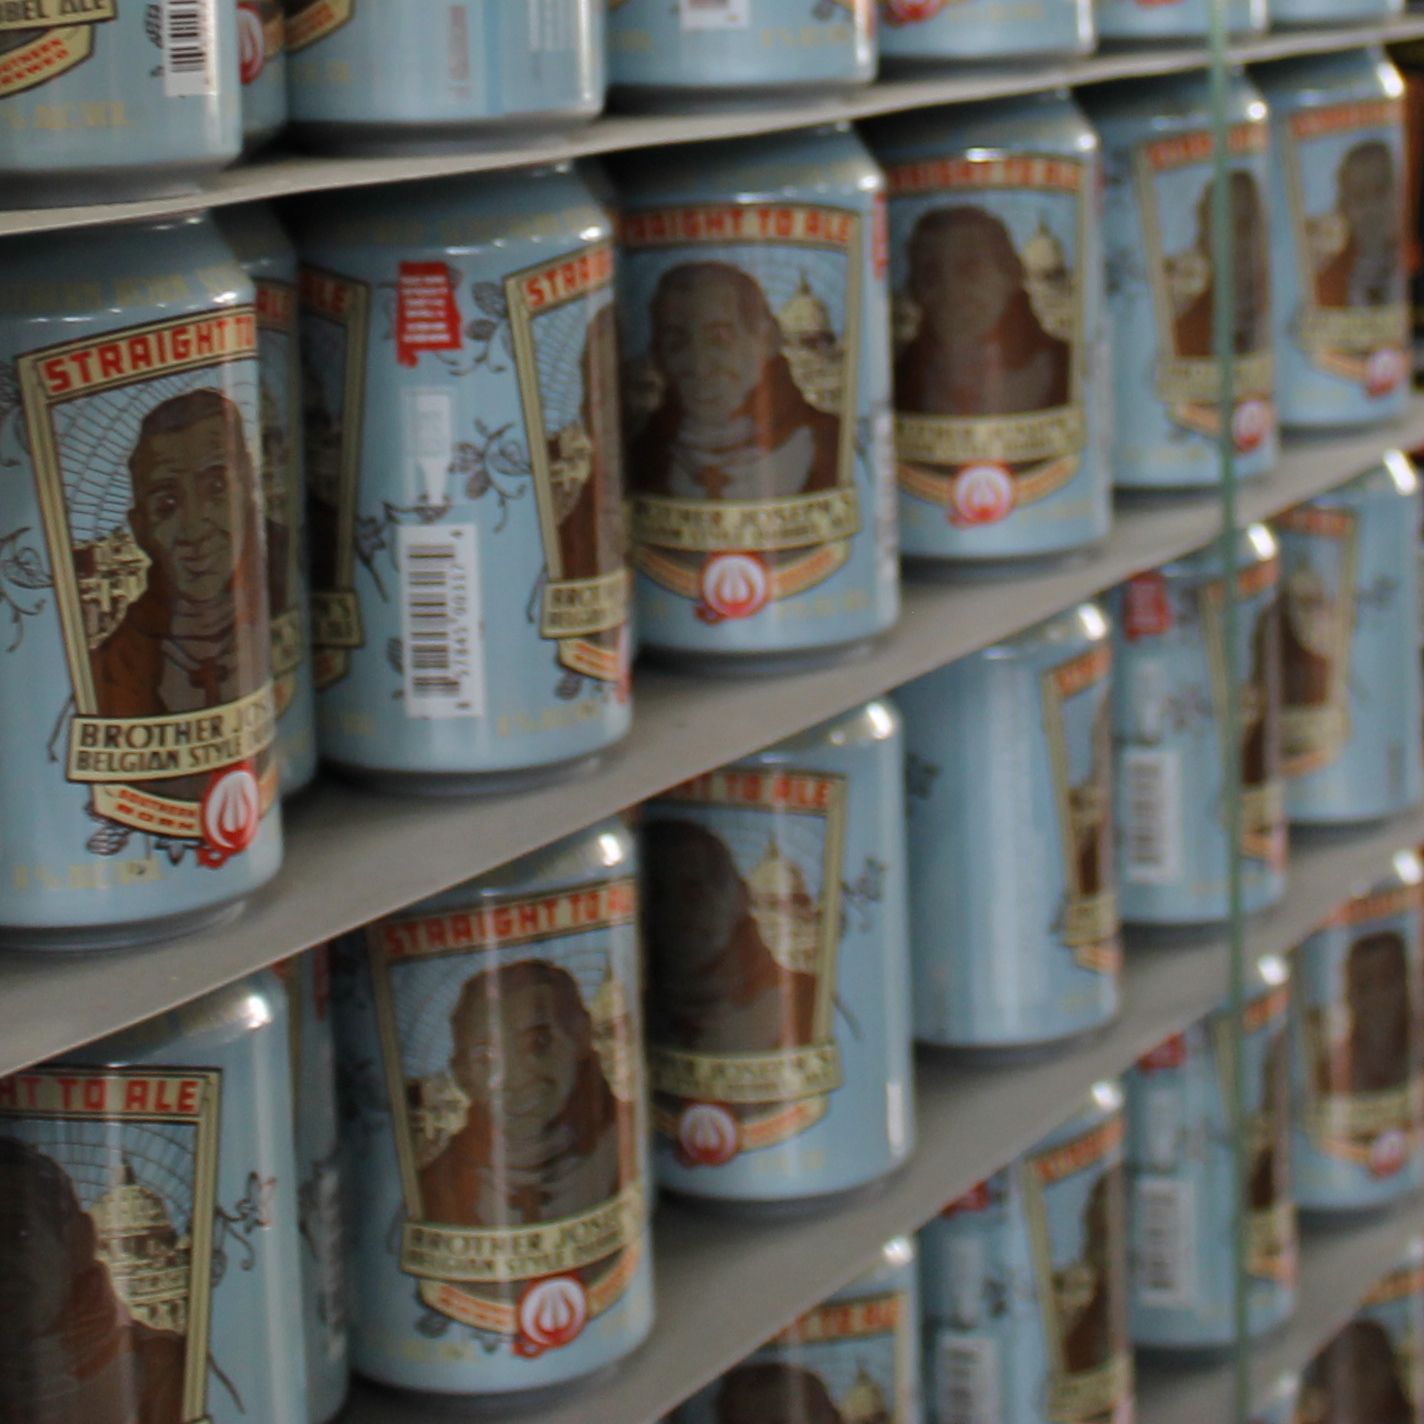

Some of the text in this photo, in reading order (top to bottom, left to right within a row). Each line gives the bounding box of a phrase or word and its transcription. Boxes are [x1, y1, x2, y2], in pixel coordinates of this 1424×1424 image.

[42, 317, 229, 394] STRAIGHT
[80, 714, 224, 749] BROTHER
[76, 734, 243, 773] BELGIAN STYLE
[386, 899, 559, 956] STRAIGHT
[56, 1077, 109, 1111] TO
[124, 1078, 199, 1113] ALE
